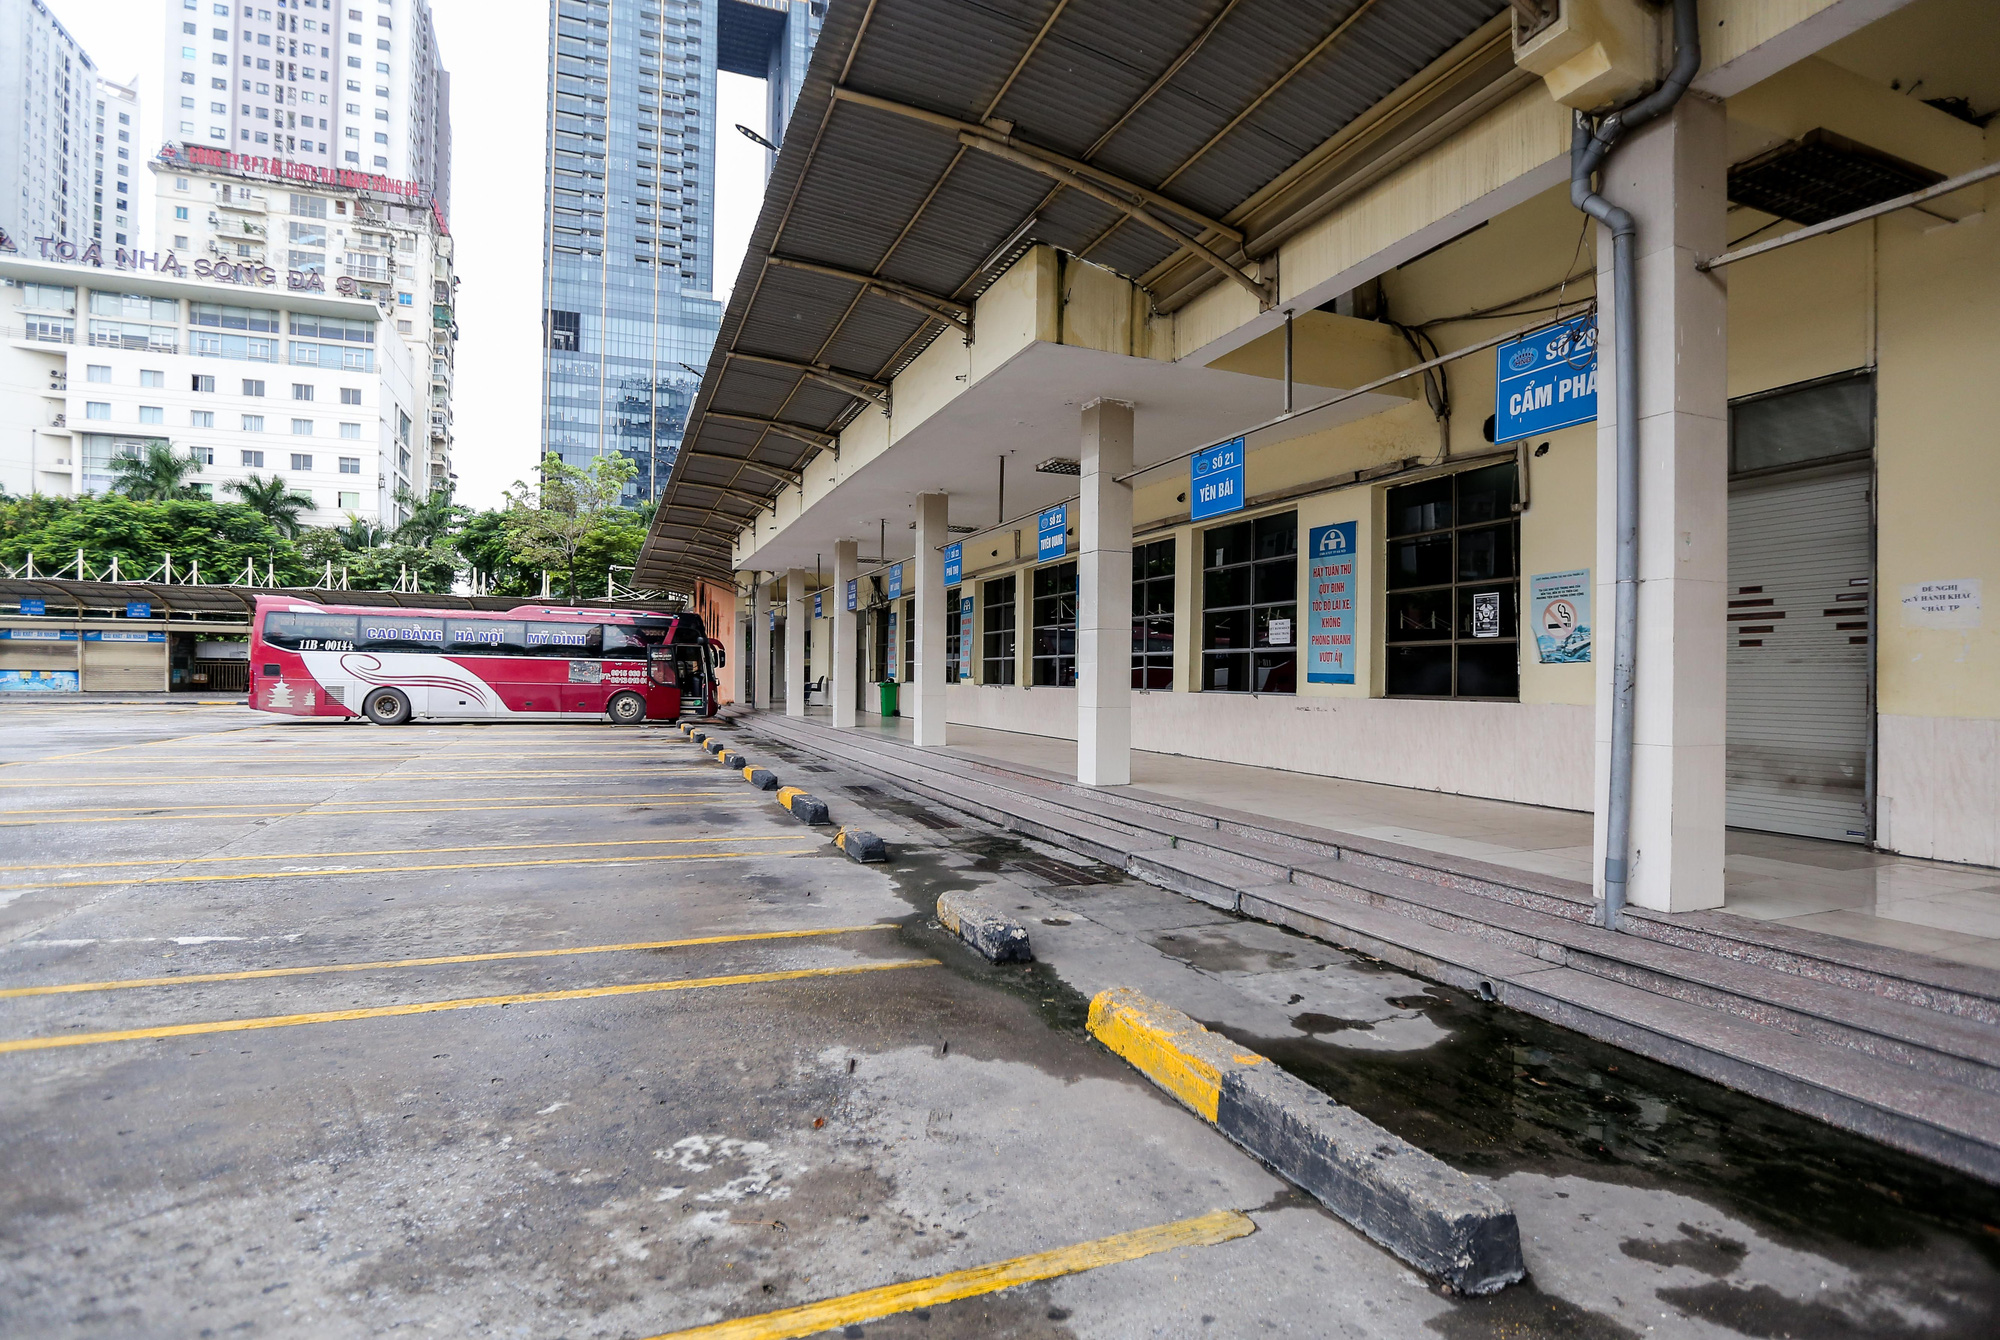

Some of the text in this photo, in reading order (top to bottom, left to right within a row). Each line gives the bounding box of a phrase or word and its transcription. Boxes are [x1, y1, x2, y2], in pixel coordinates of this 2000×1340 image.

[225, 152, 239, 169] TY
[243, 155, 259, 172] CP
[372, 174, 401, 193] SÔNG
[34, 236, 358, 294] TOÀ NHÀ SÔNG ĐÀ 9
[1545, 329, 1571, 361] SỐ
[1509, 363, 1598, 416] CẨM PHẢ
[1212, 451, 1234, 469] SỐ 21
[1200, 477, 1233, 503] YÊN BÁI
[1049, 512, 1062, 525] SỐ 22
[1051, 533, 1063, 548] QUANG
[1312, 560, 1352, 578] HÃY TUÂN THỦ
[1319, 582, 1345, 596] QUY ĐỊNH
[1935, 584, 1958, 592] NGHỊ
[1312, 599, 1323, 612] TỐC
[1323, 599, 1331, 613] ĐỘ
[1332, 597, 1341, 610] LÁI
[1321, 616, 1341, 628] KHÔNG
[366, 623, 587, 646] CAO BẰNG HÀ NỘI MỸ ĐÌNH
[1311, 633, 1351, 645] PHÓNG NHANH
[1319, 651, 1333, 665] VƯỢT
